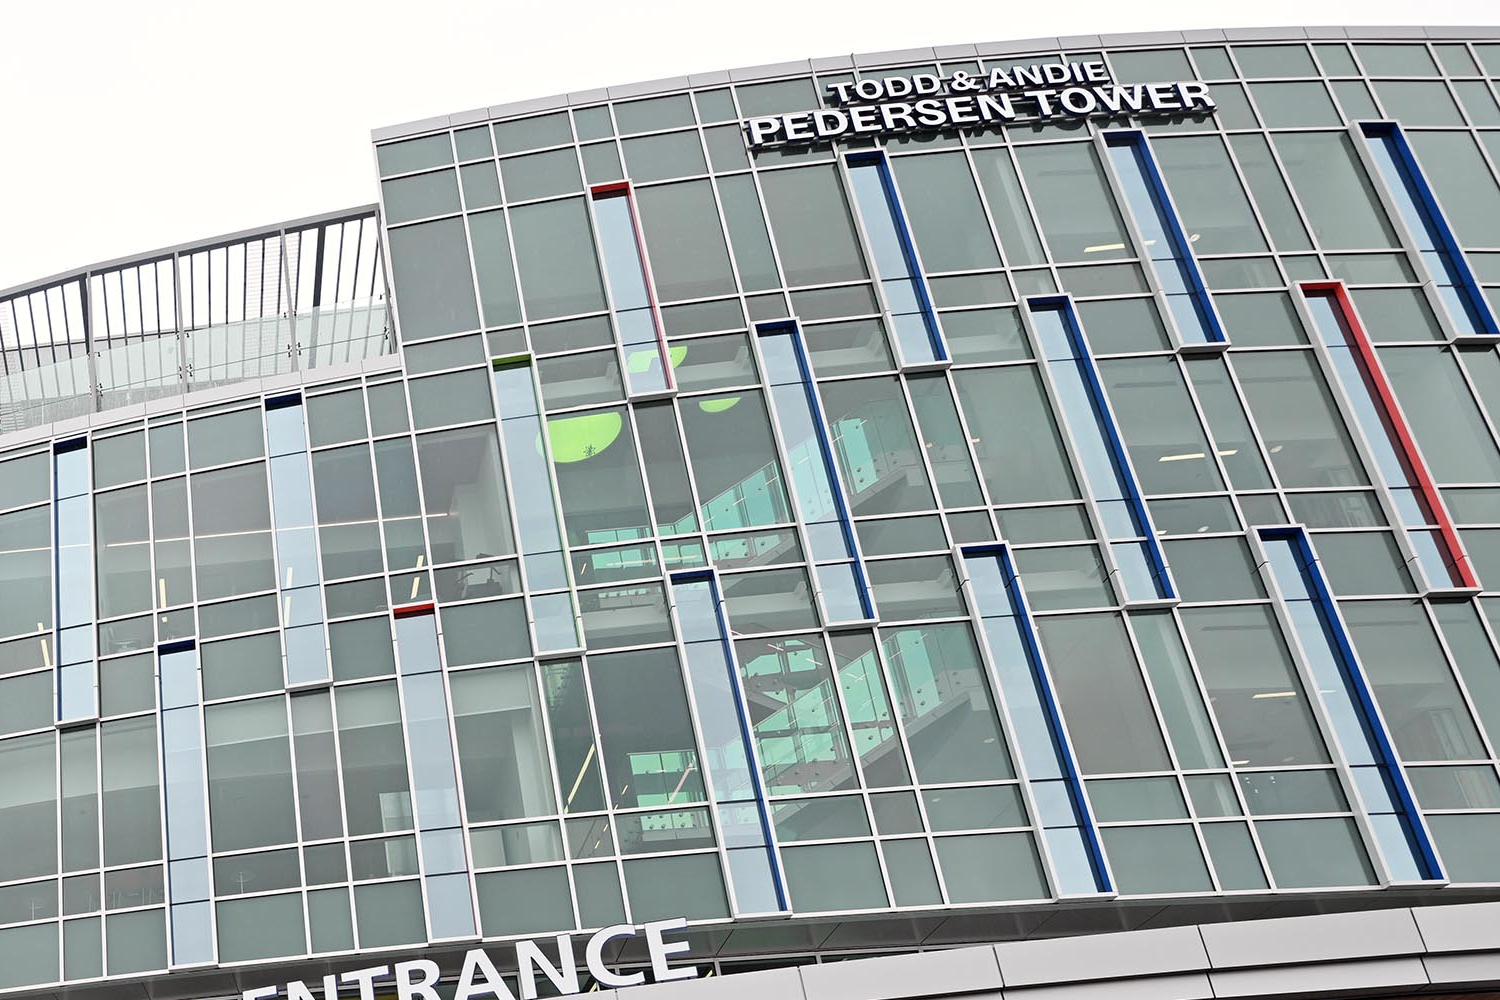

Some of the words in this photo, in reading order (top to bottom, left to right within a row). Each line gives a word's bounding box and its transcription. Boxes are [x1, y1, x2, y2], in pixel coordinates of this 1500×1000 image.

[826, 73, 941, 104] TODD
[950, 70, 981, 92] &
[988, 61, 1111, 89] ANDIE
[749, 92, 1017, 146] PEDERSEN
[1023, 81, 1217, 116] TOWER
